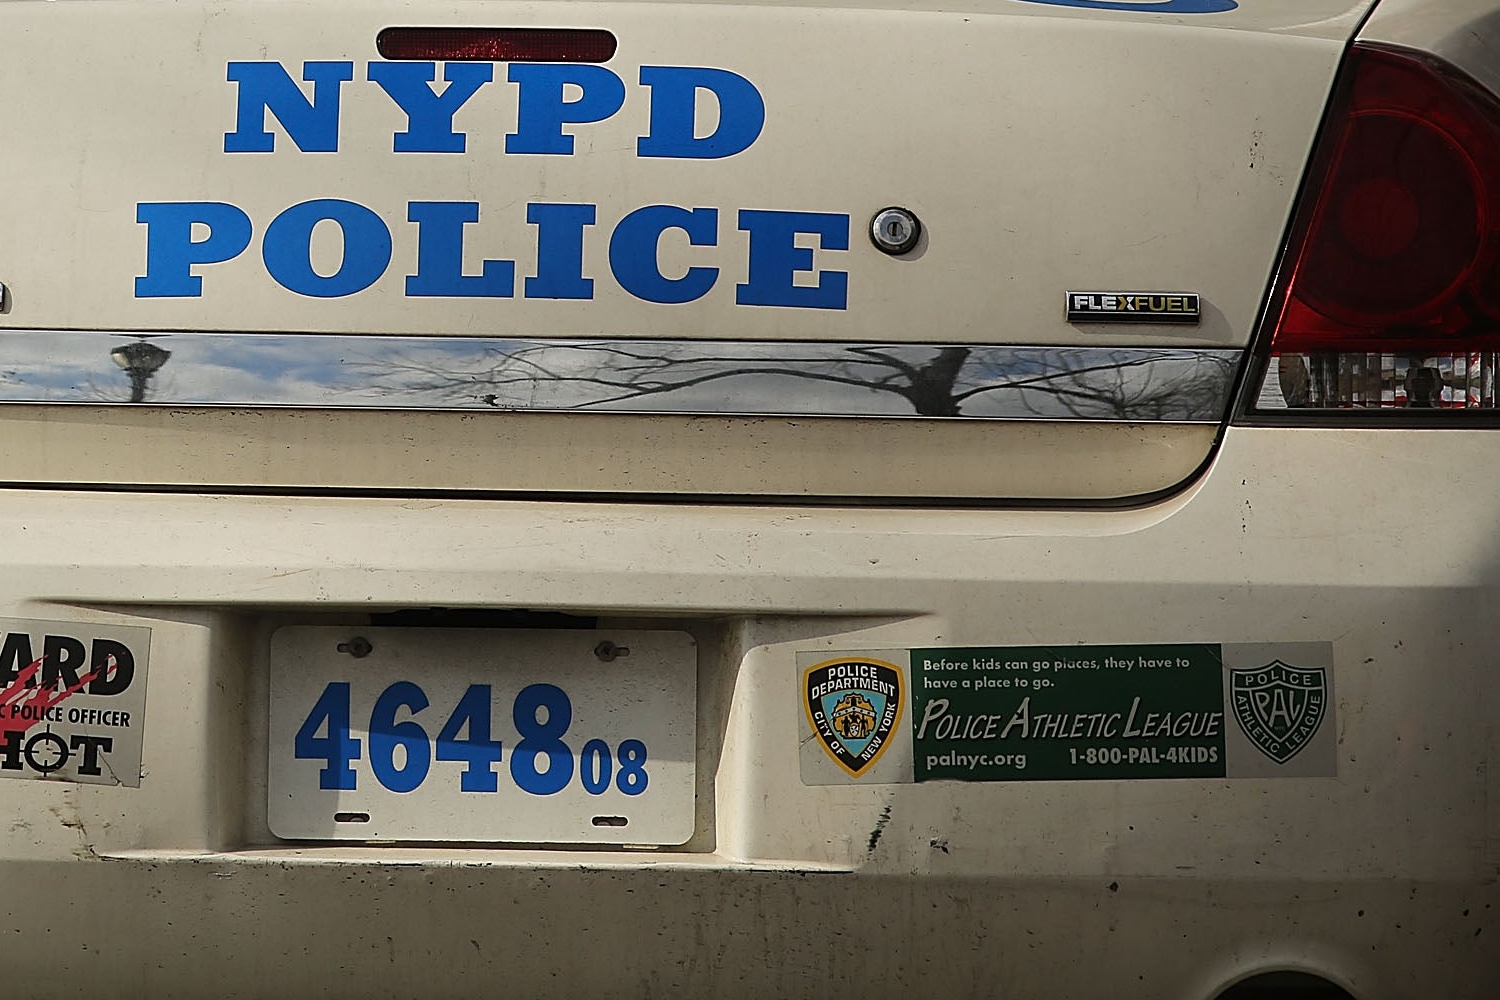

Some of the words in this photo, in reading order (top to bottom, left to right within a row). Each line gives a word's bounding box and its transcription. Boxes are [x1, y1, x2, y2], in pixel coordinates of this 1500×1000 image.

[223, 61, 766, 159] NYPD
[133, 197, 850, 310] POLICE
[1074, 295, 1196, 312] FLEXFUEL
[828, 665, 878, 680] POLICE
[923, 658, 969, 671] Before
[972, 658, 1002, 670] kids
[1004, 660, 1029, 670] can
[1032, 661, 1050, 672] go
[1054, 657, 1100, 672] places,
[1104, 656, 1135, 671] they
[1138, 656, 1172, 668] have
[1176, 657, 1190, 668] to
[811, 677, 896, 700] DEPARTMENT
[923, 676, 958, 689] have
[961, 680, 971, 688] a
[974, 675, 1011, 691] place
[1014, 677, 1028, 688] to
[1032, 678, 1055, 690] go.
[1245, 670, 1312, 686] POLICE
[11, 705, 63, 723] POLICE
[68, 708, 130, 728] OFFICER
[916, 698, 1002, 740] POLICE
[1000, 696, 1122, 739] ATHLETIC
[1122, 696, 1223, 738] LEAGUE
[1255, 688, 1301, 728] PAL
[814, 711, 833, 738] CITY
[830, 740, 846, 756] OF
[861, 736, 882, 761] NEW
[879, 702, 896, 733] YORK
[1237, 695, 1280, 753] ATHLETIC
[1285, 696, 1320, 750] LEAGUE
[294, 681, 575, 795] 4648
[926, 750, 1028, 771] palnyc.org
[1069, 746, 1219, 765] 1-800-PAL-4KIDS
